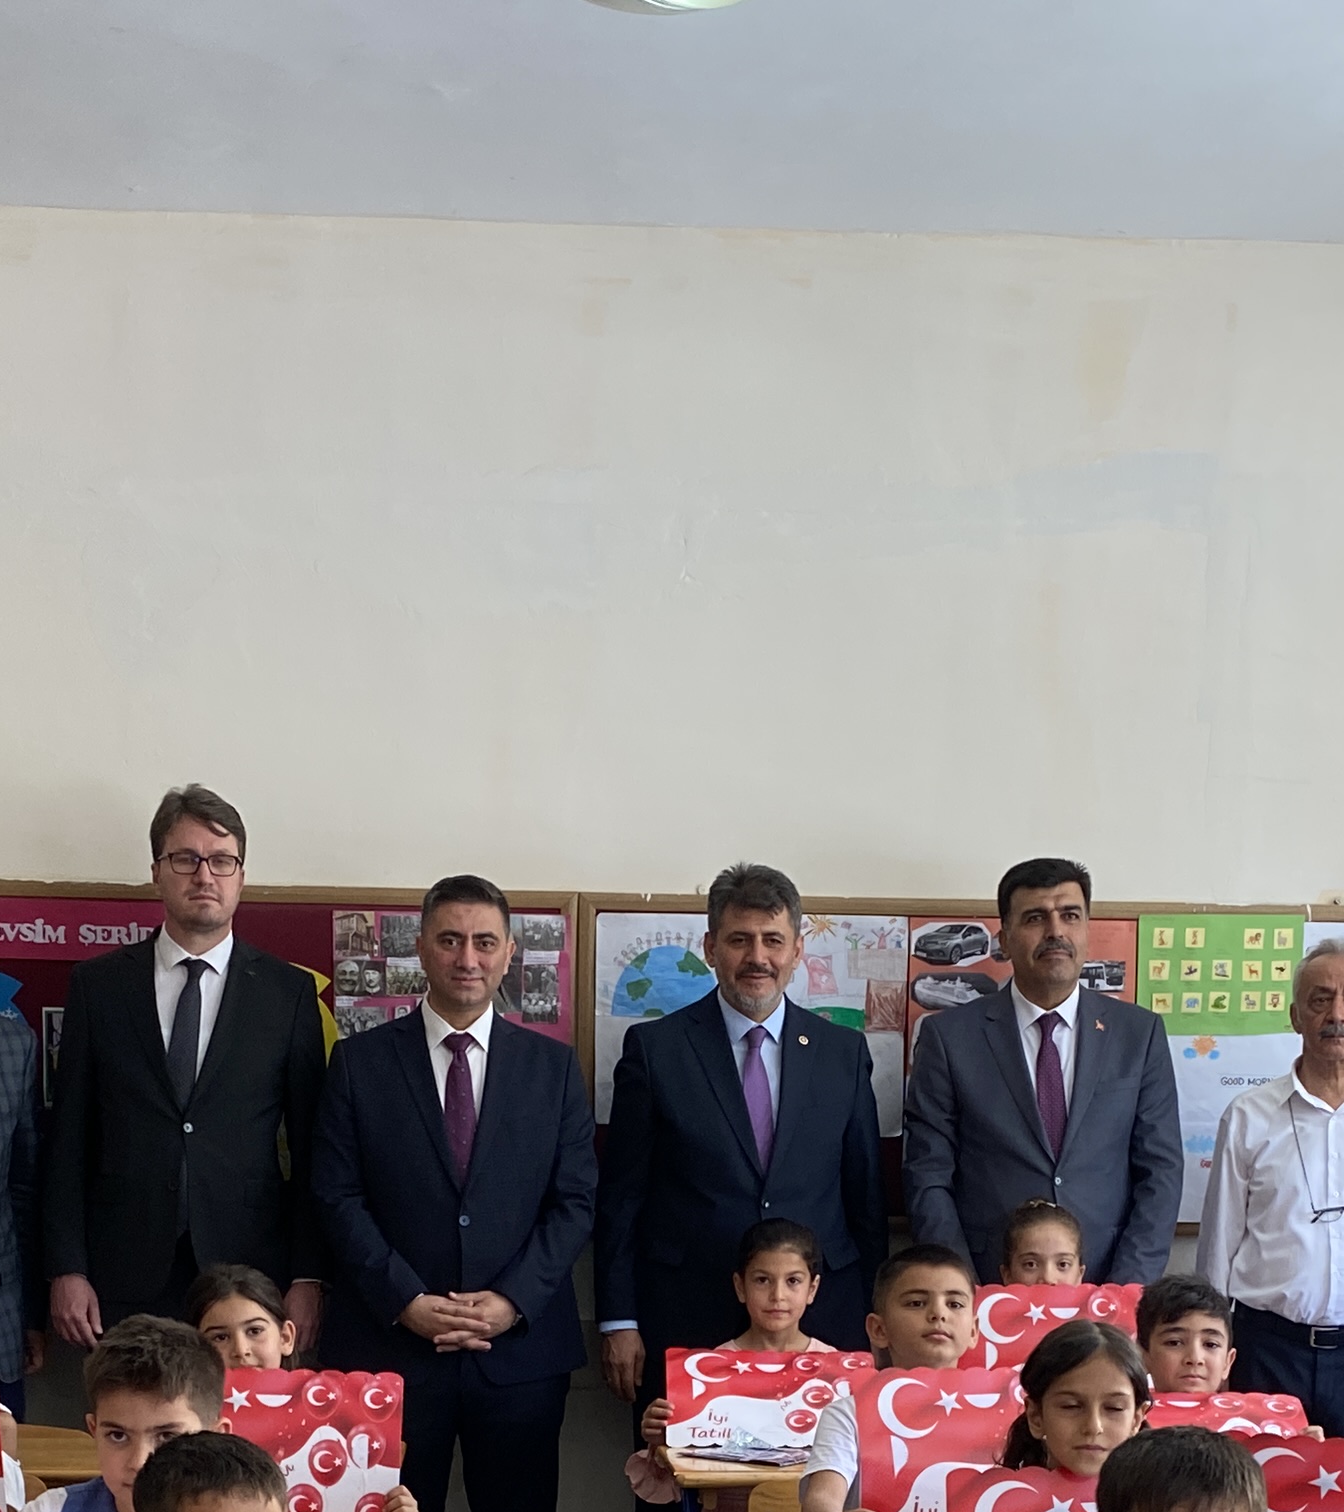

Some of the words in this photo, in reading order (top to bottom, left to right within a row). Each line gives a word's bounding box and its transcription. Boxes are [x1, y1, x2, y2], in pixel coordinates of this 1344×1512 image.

[1220, 1076, 1245, 1086] GOOD
[708, 1409, 728, 1425] İyi
[687, 1425, 731, 1439] Tatill
